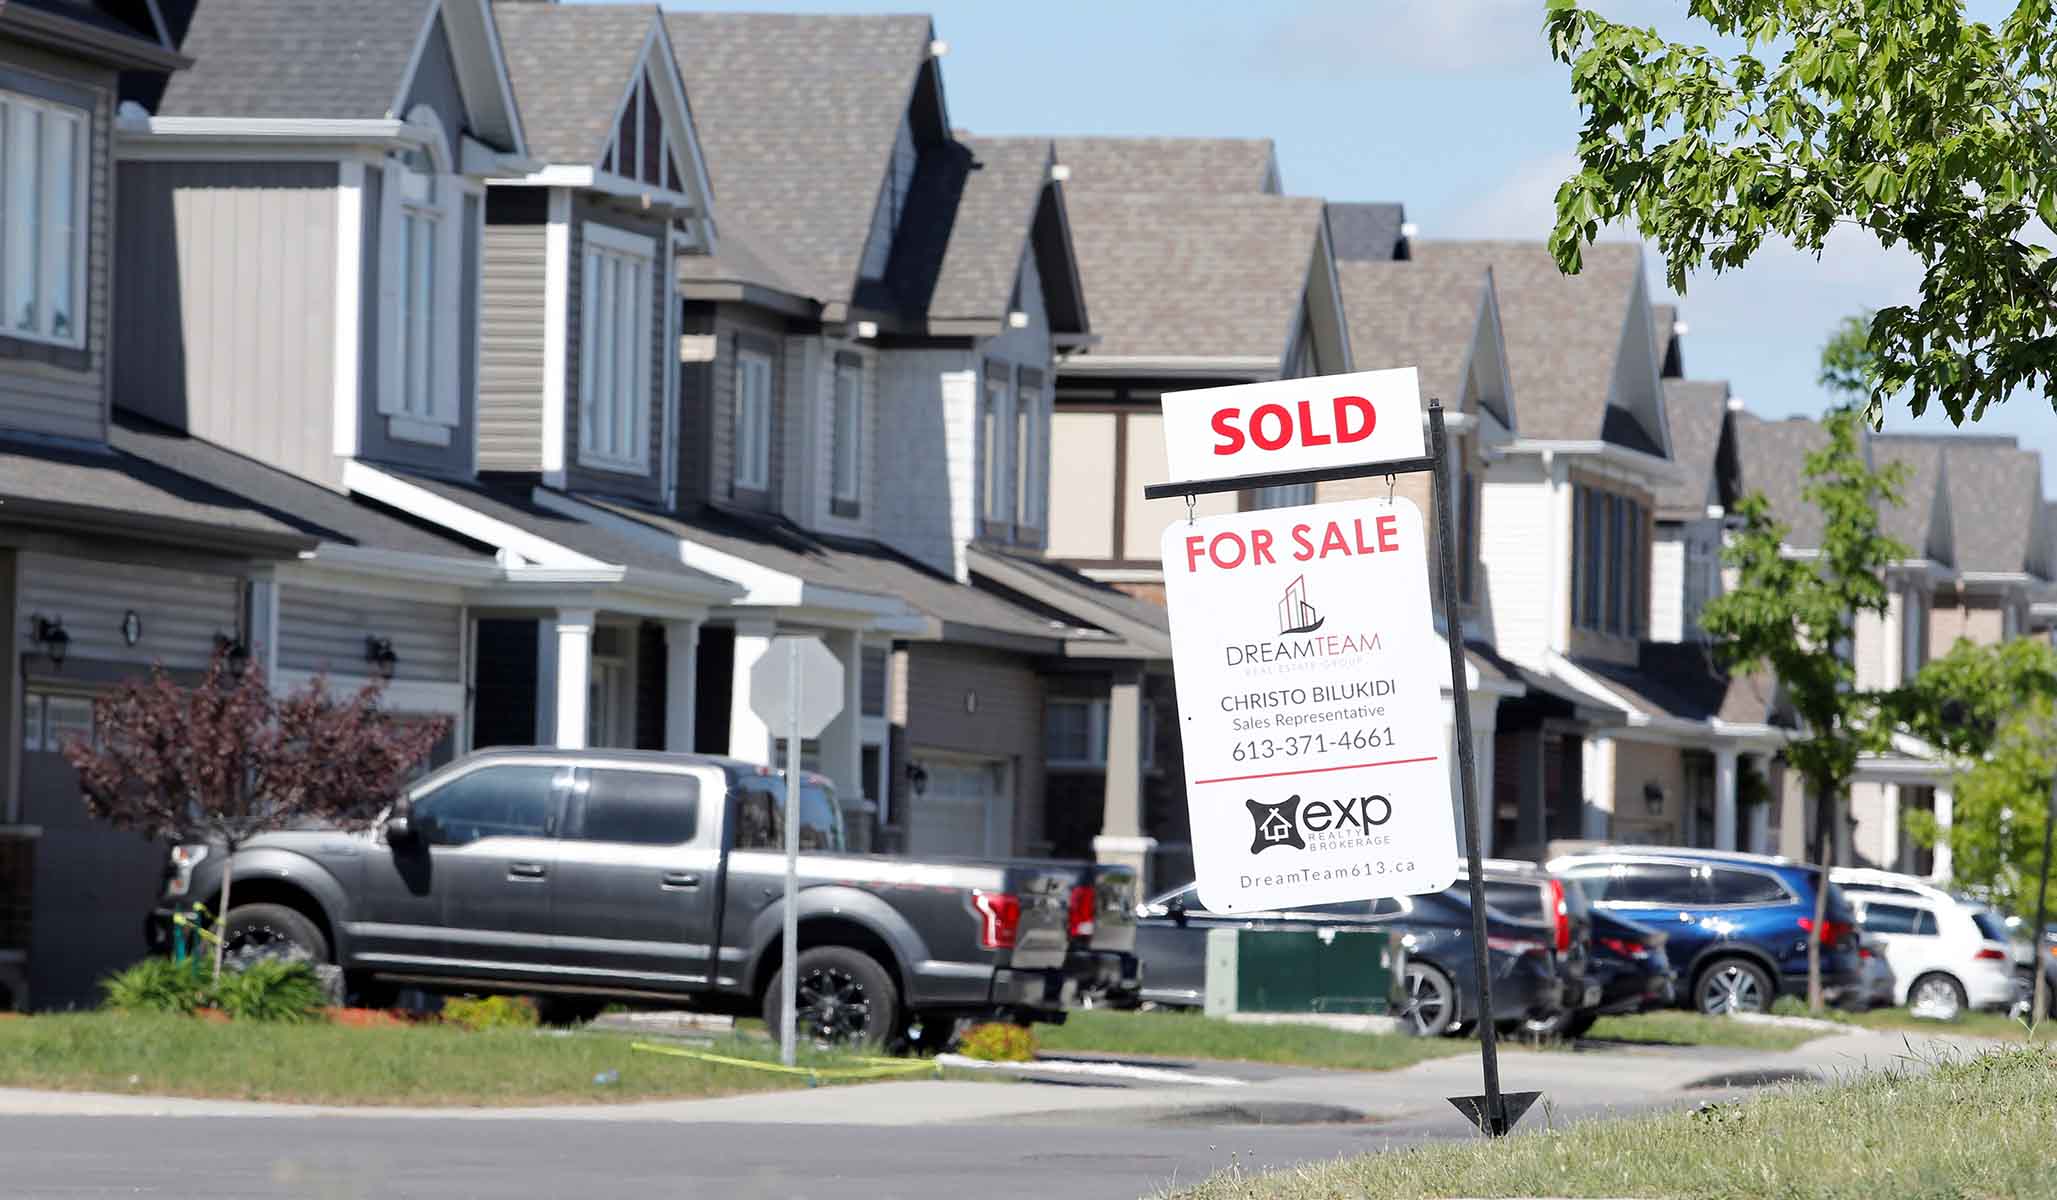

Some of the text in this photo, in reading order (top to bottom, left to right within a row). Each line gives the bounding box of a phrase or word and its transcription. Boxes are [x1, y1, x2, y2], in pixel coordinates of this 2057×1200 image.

[1211, 396, 1377, 455] SOLD
[1186, 515, 1399, 572] FOR SALE
[1227, 633, 1382, 667] DREAMTEAM
[1221, 680, 1395, 711] CHRISTO BILUKIDI
[1232, 706, 1385, 731] Sales Representative
[1232, 728, 1395, 761] 613-371-4661
[1302, 794, 1392, 837] exp
[1308, 829, 1361, 842] REALTY
[1309, 836, 1391, 851] BROKERAGE
[1240, 861, 1416, 888] DreamTeam613.ca
